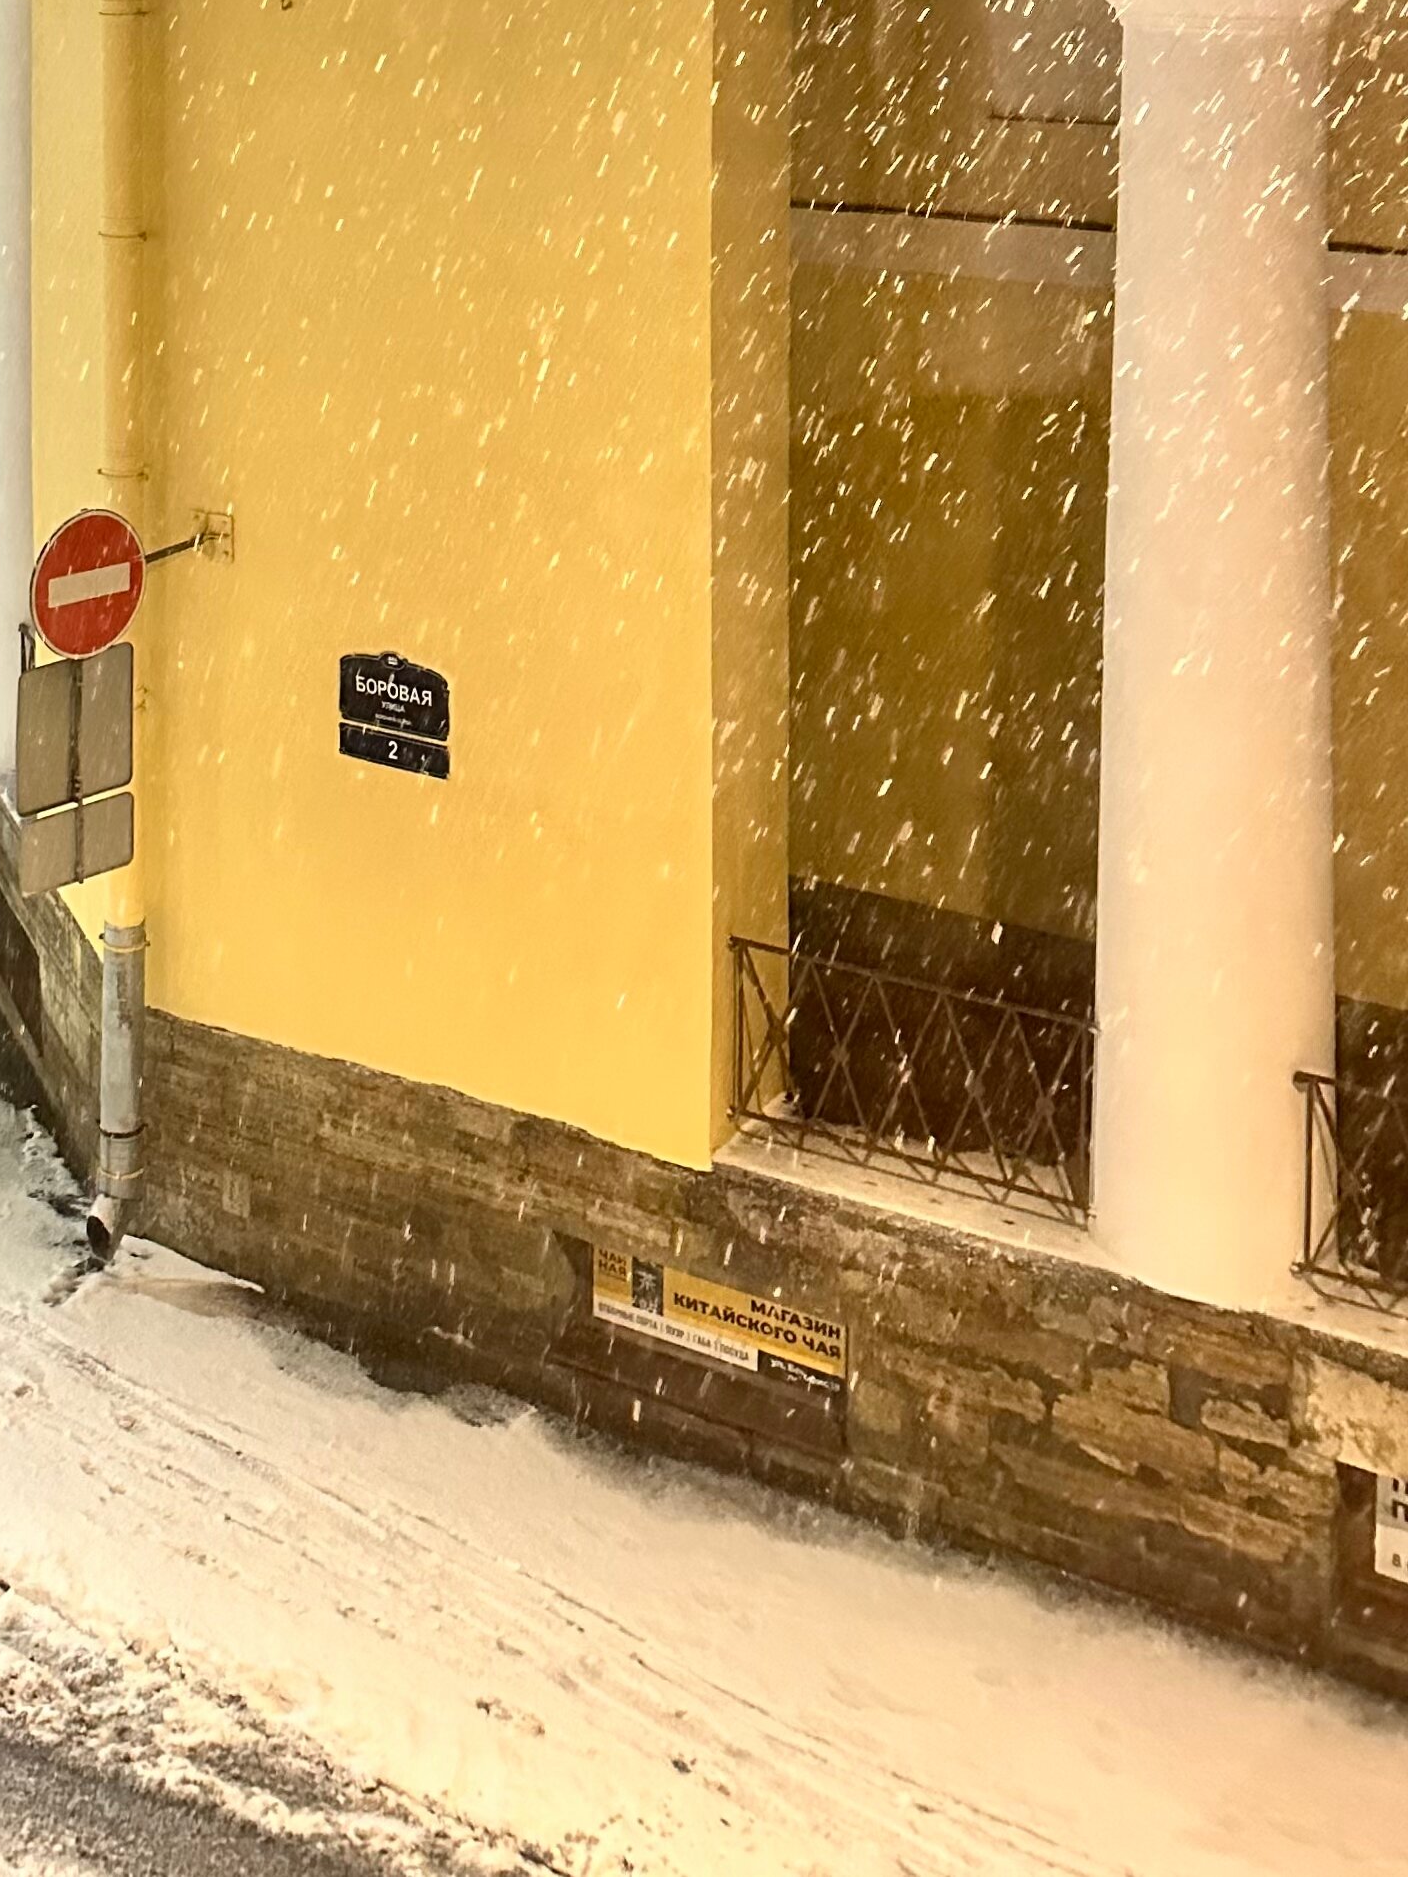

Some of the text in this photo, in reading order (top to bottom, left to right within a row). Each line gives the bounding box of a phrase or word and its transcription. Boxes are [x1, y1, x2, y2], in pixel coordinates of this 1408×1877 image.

[356, 675, 433, 707] БОРОВАЯ
[388, 740, 398, 760] 2
[673, 1292, 797, 1344] КИТАЙСКОГО
[802, 1334, 841, 1360] ЧАЯ
[750, 1299, 841, 1340] МАГАЗИН
